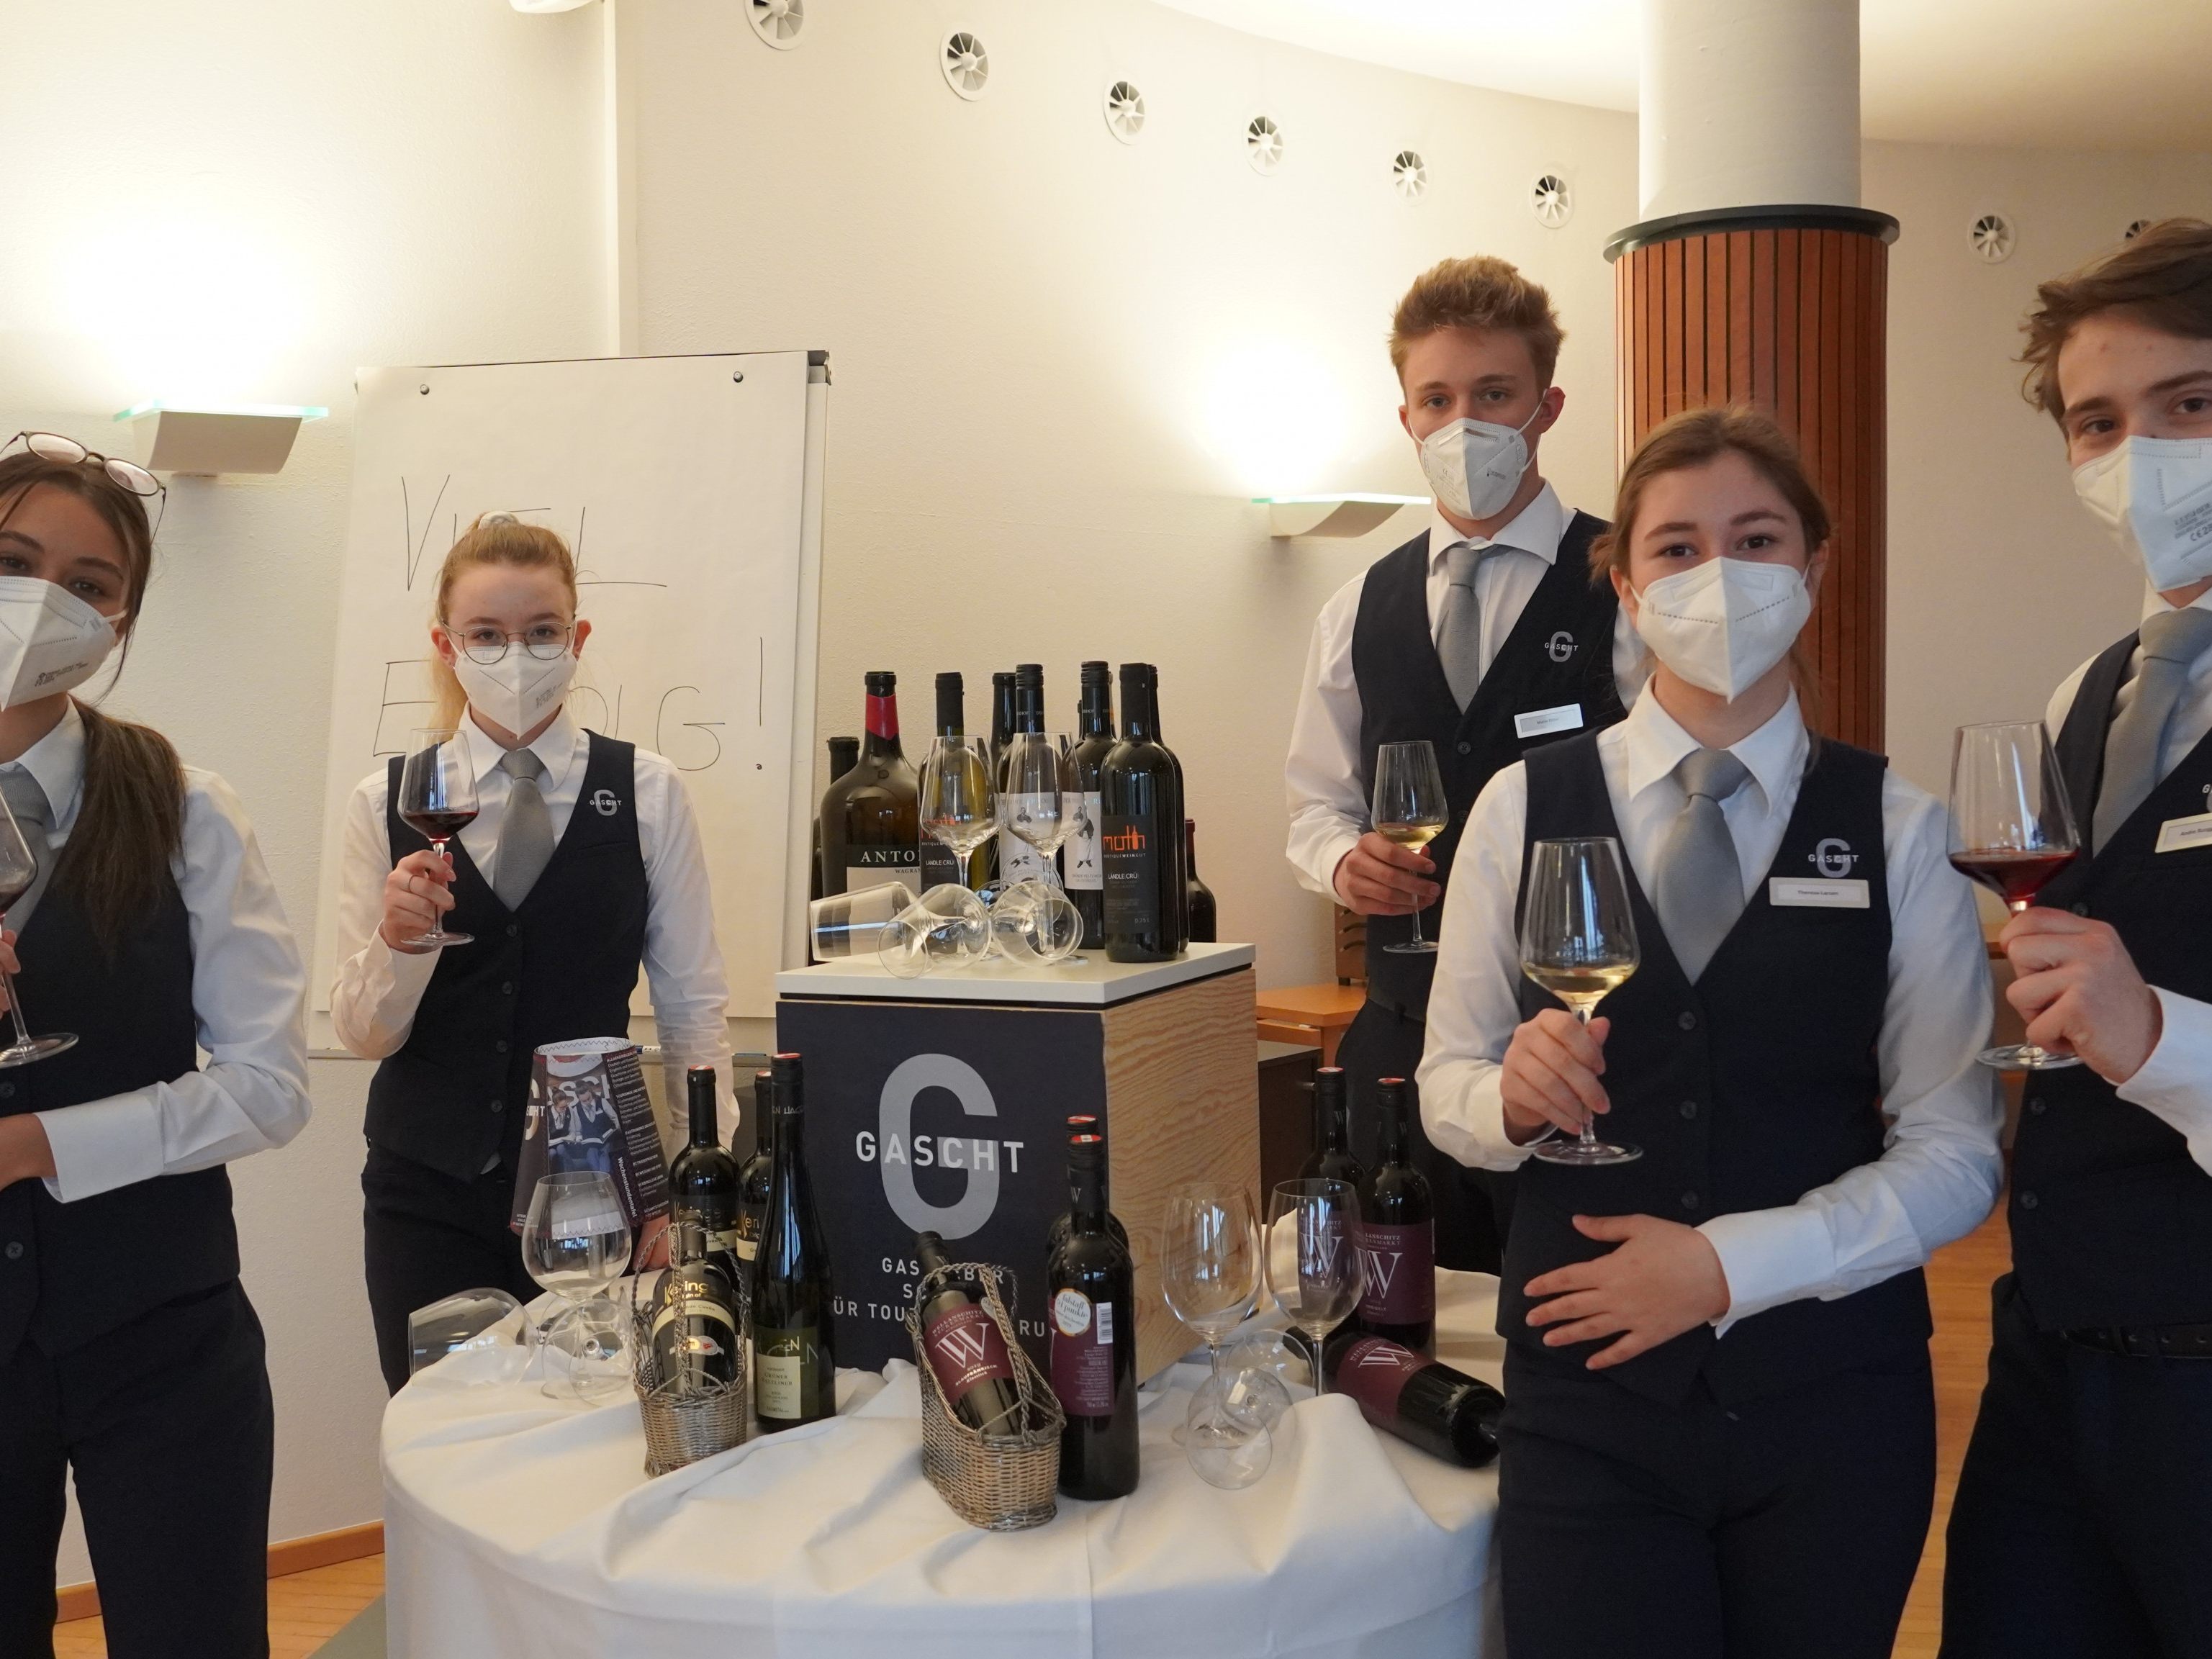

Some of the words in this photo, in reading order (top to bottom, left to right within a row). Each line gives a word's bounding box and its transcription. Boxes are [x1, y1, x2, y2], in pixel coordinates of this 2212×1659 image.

[1544, 643, 1578, 651] GASCHT
[860, 850, 920, 863] ANTO
[1807, 854, 1859, 863] GASCHT
[856, 1131, 1024, 1173] GASCHT
[618, 1157, 638, 1218] Wochenstundentafel
[935, 1323, 990, 1368] W
